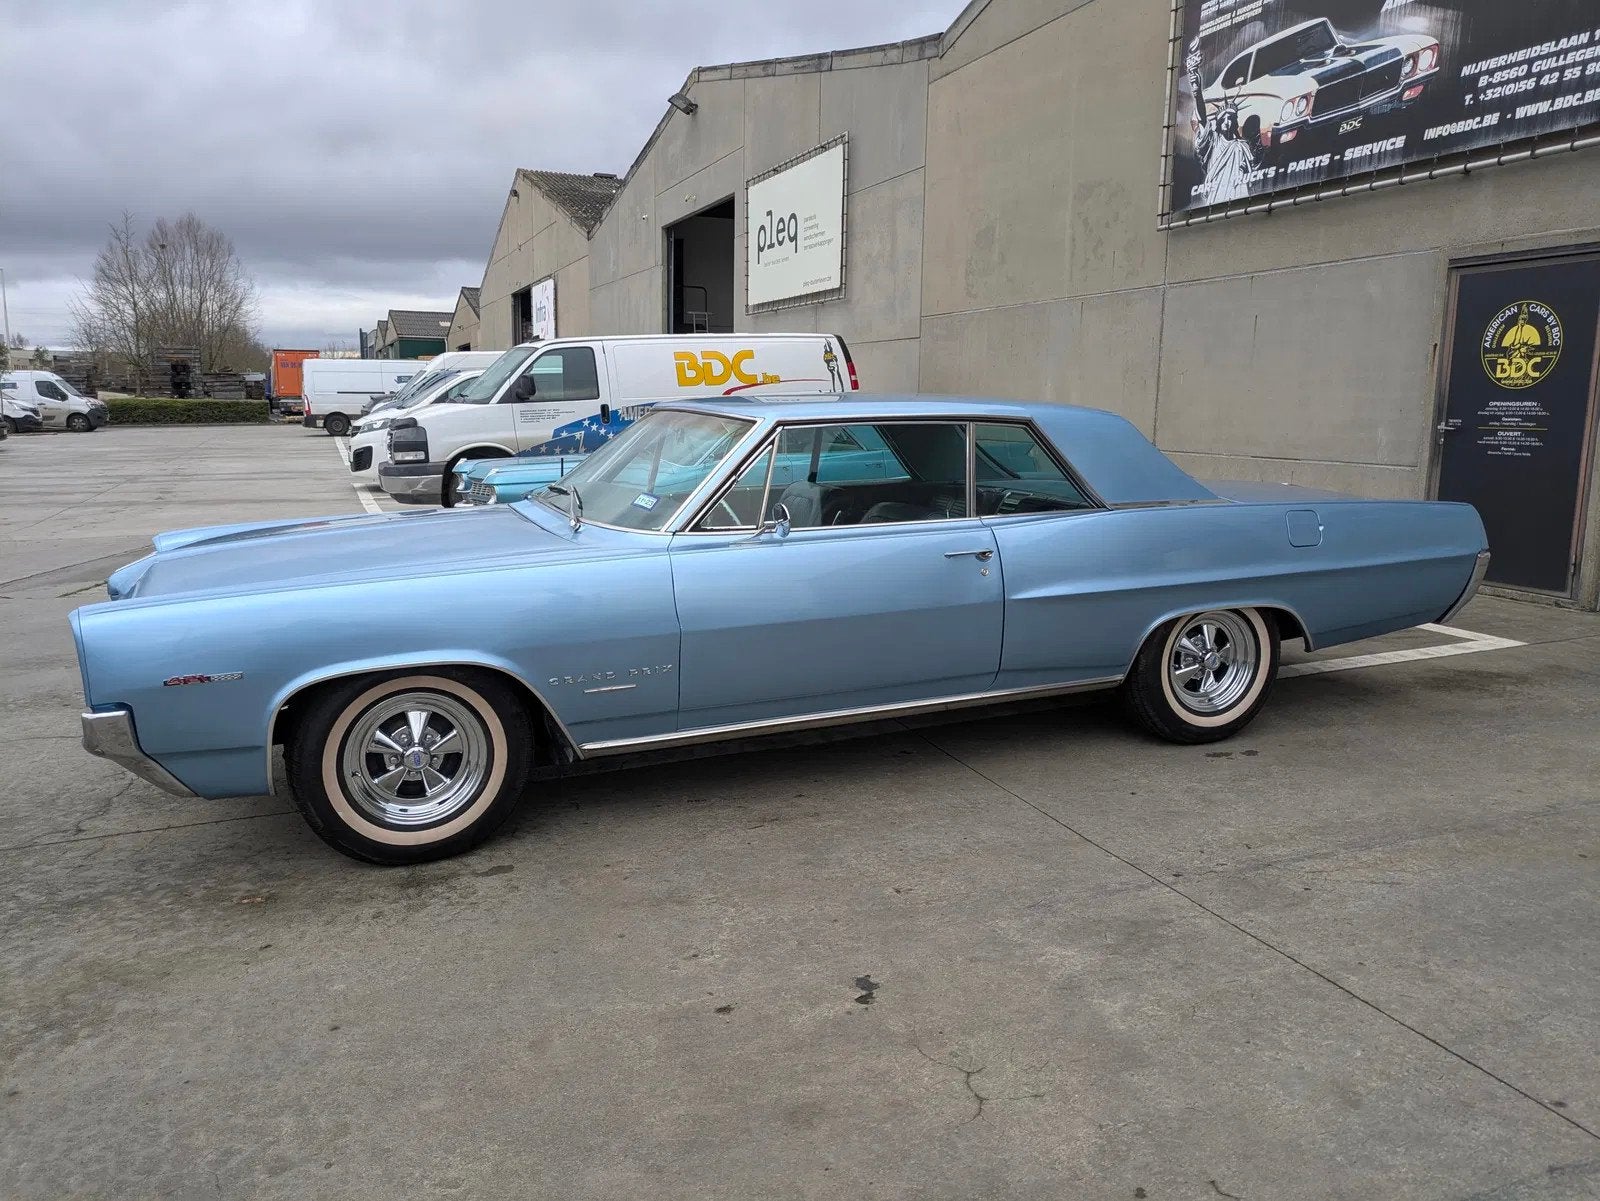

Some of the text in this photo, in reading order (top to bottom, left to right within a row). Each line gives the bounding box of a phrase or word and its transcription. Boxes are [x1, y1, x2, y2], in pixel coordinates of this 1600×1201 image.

[1460, 31, 1590, 77] NIJVERHEIDSLAAN
[1464, 93, 1474, 106] T.
[1479, 76, 1537, 102] +32(0)56
[1540, 71, 1560, 85] 42
[1562, 66, 1582, 81] 55
[1478, 64, 1528, 88] B-8560
[1339, 117, 1363, 132] BDC
[1423, 112, 1500, 141] INFO@BDC.BE
[1515, 88, 1600, 119] WWW.BDC.BE
[1287, 153, 1332, 174] PARTS
[1343, 135, 1407, 162] SERVICE
[757, 209, 799, 265] pleq
[1483, 303, 1561, 349] AMERICAN CARS BY BDC
[1495, 356, 1542, 378] BDC
[548, 664, 673, 687] GRAND PRIX
